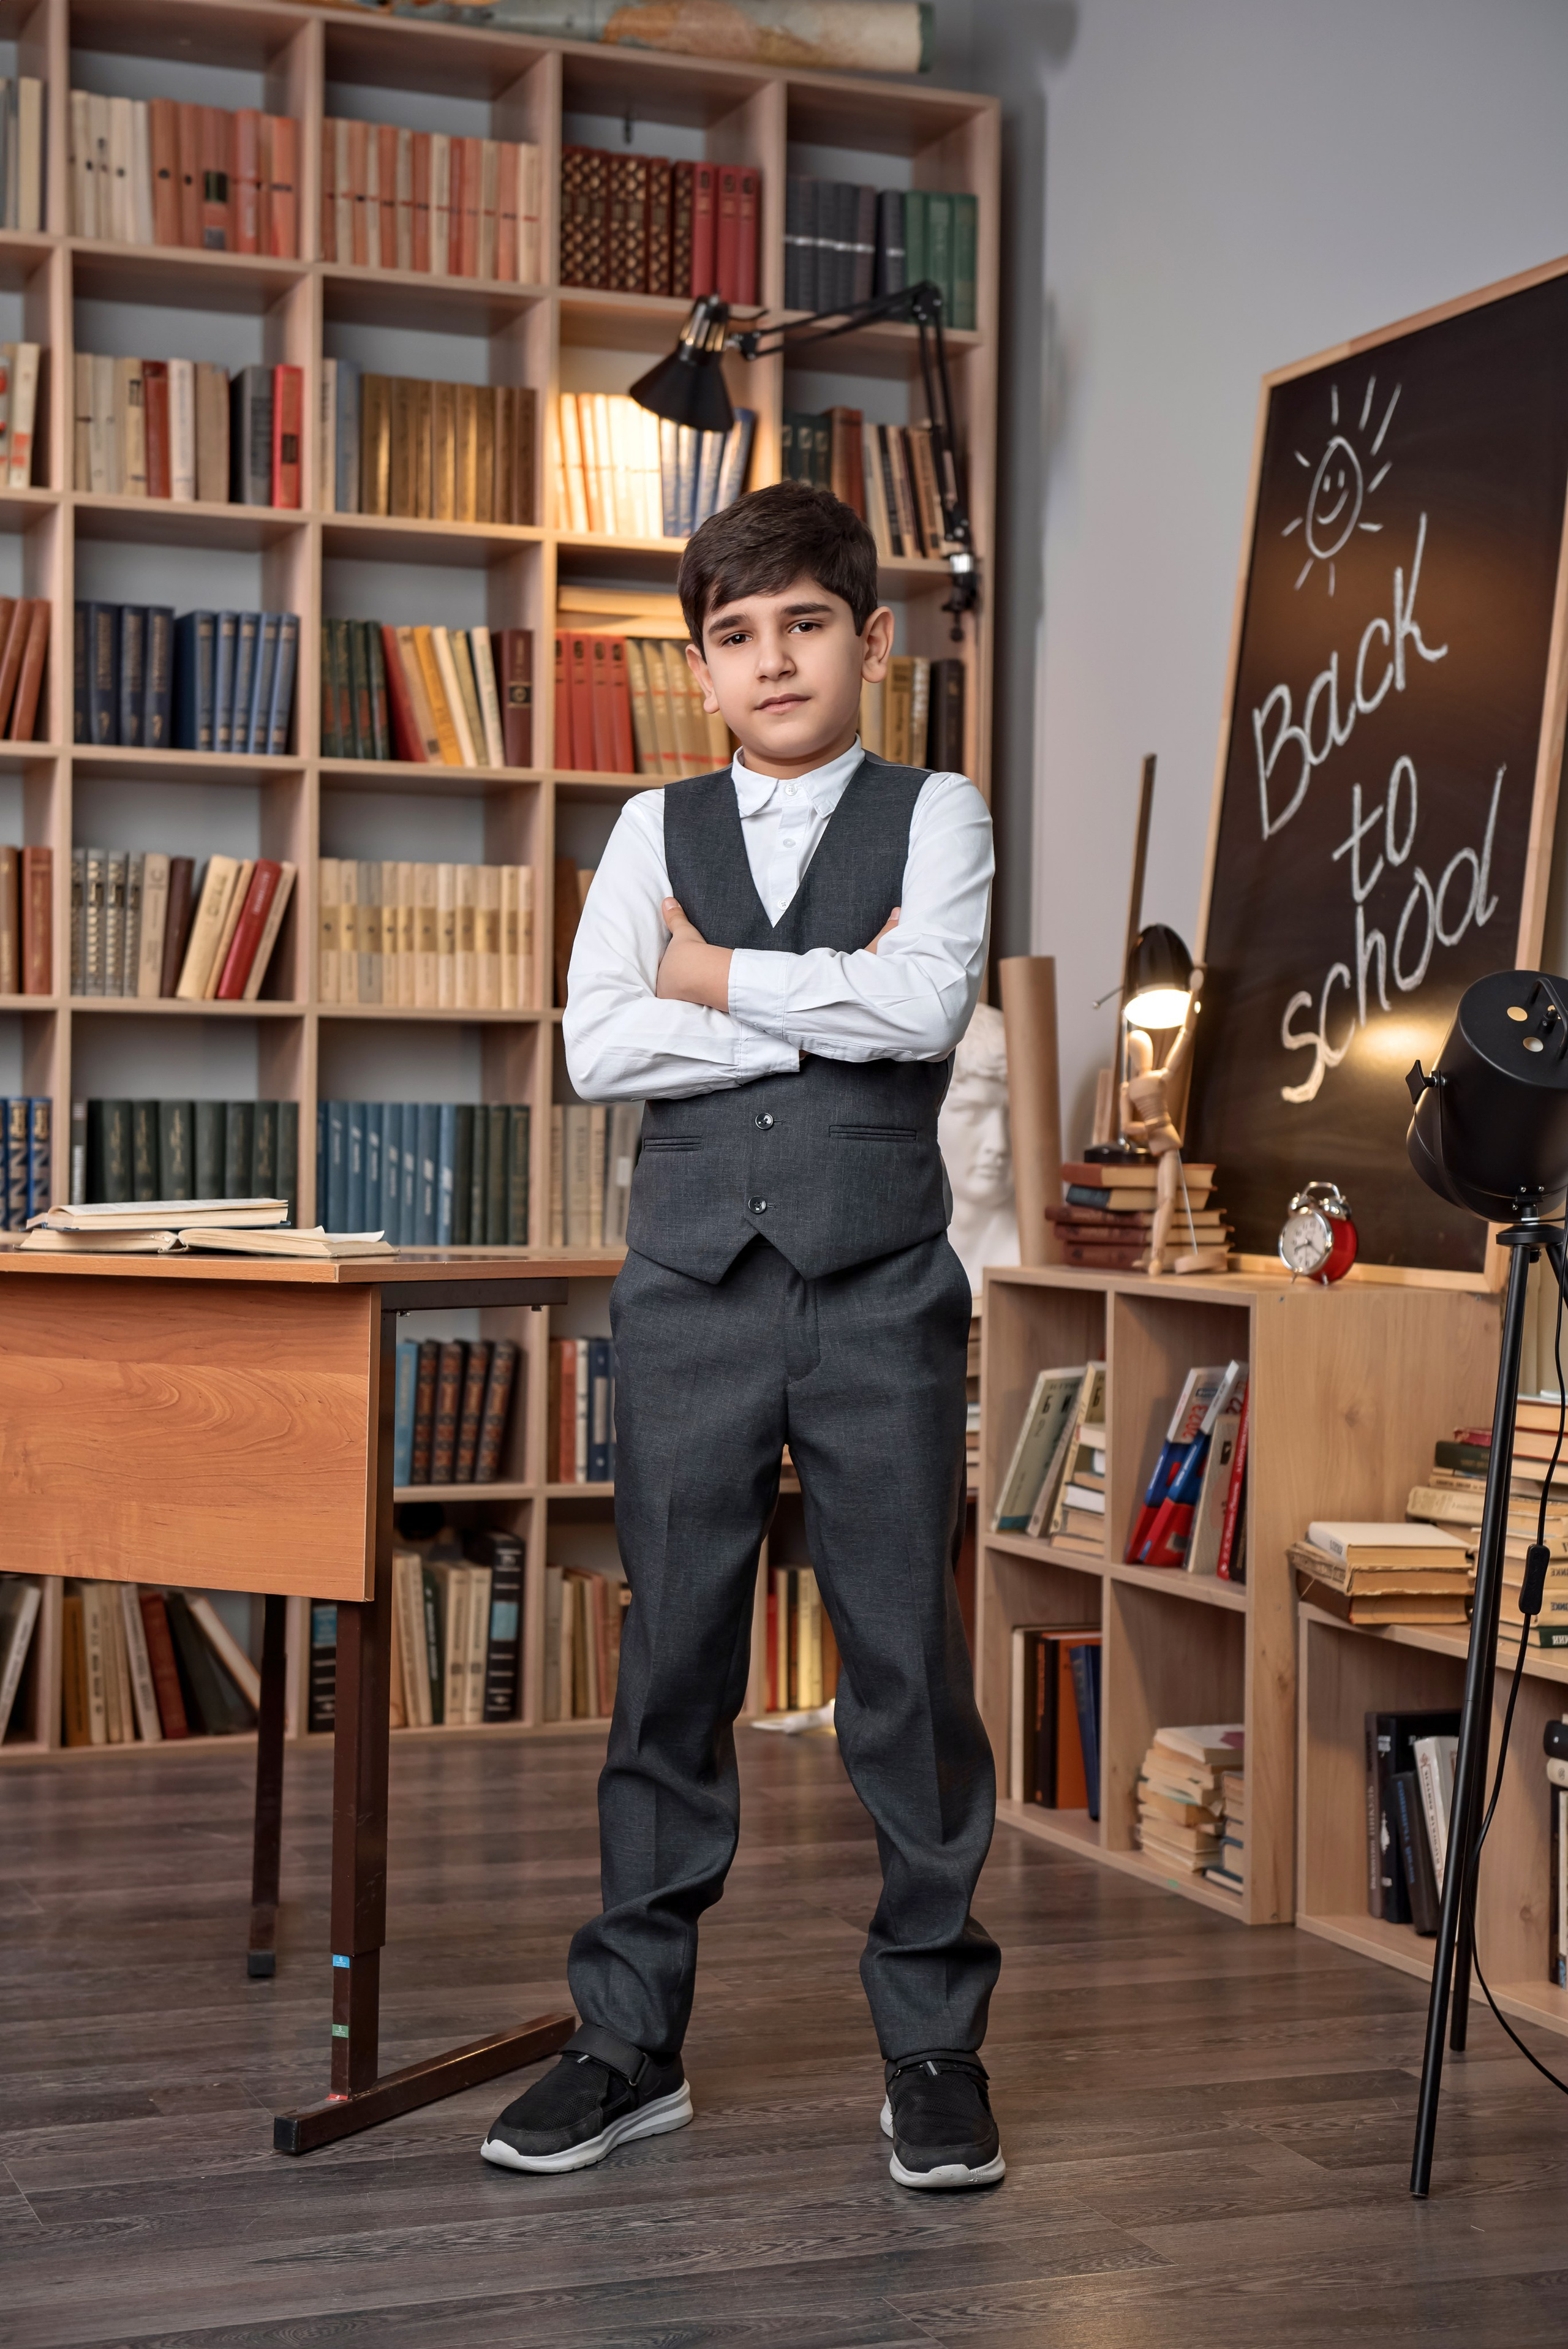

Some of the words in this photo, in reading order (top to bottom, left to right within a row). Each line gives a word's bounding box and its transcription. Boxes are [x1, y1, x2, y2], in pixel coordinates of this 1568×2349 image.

[1253, 512, 1448, 840] Back
[1280, 763, 1507, 1104] school
[1332, 755, 1417, 903] to
[1182, 1404, 1208, 1439] 2023
